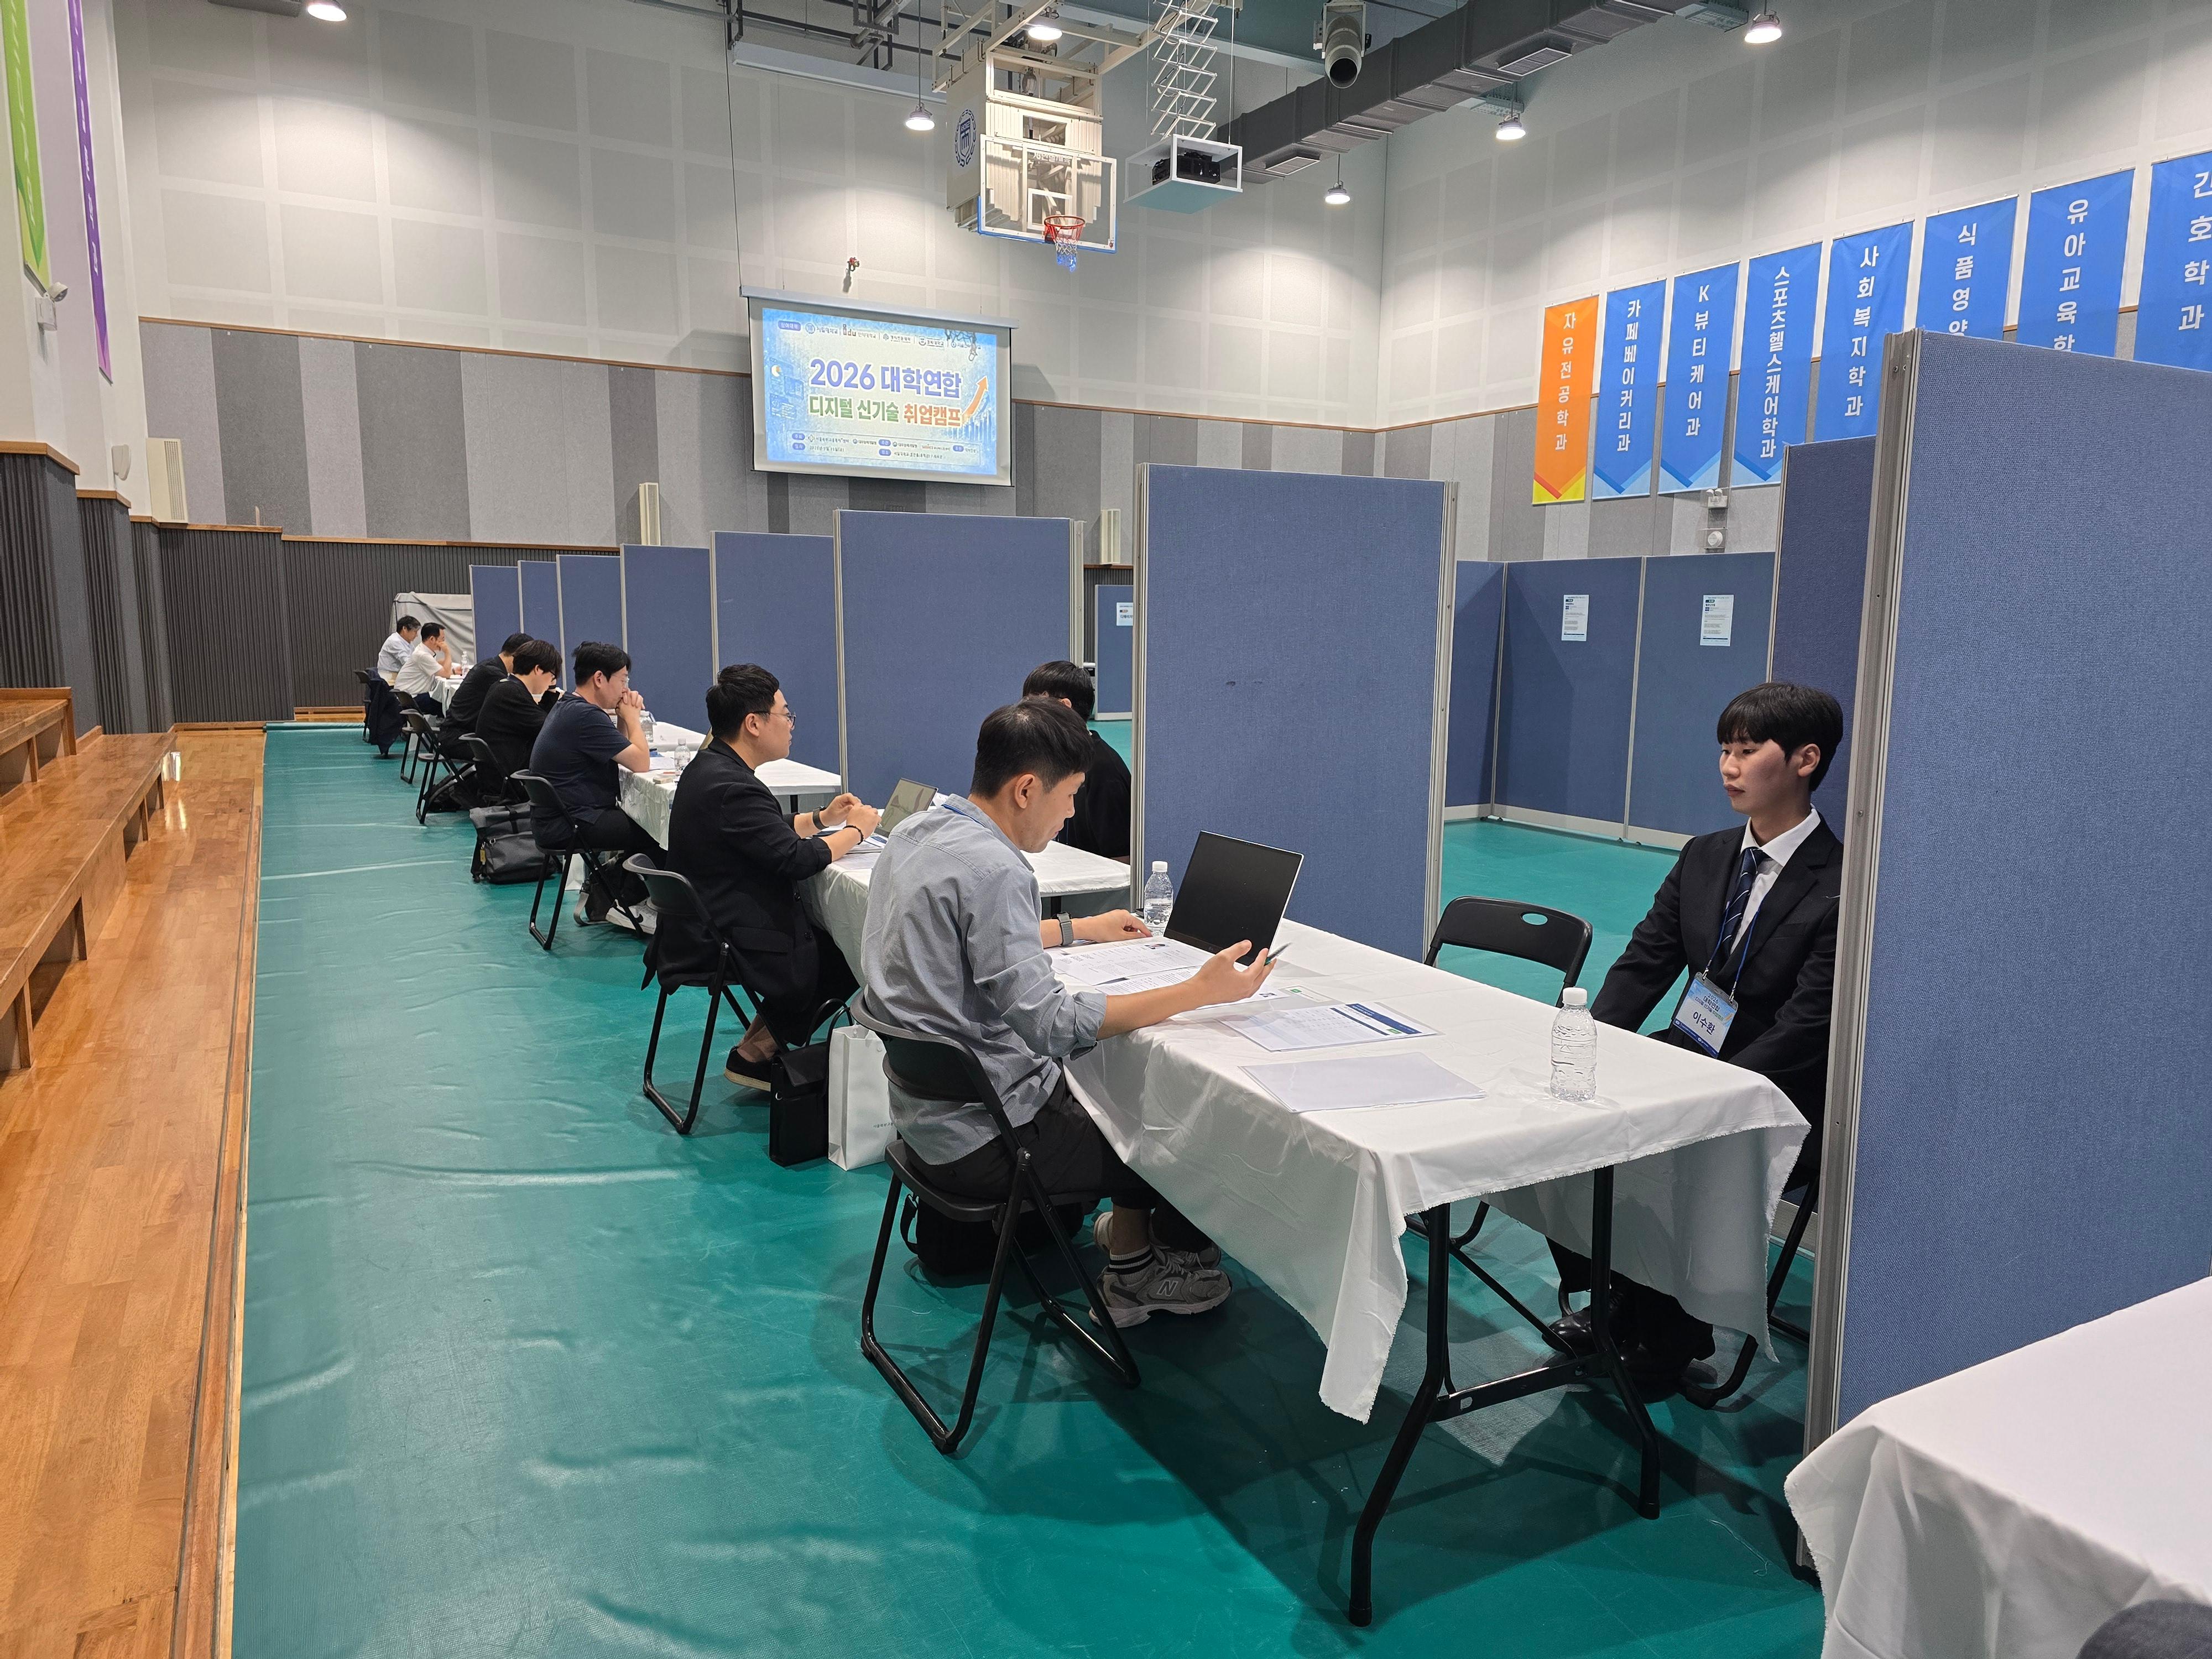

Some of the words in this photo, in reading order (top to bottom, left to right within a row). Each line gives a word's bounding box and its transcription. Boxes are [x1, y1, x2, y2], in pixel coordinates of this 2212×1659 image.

[1686, 285, 1710, 436] K뷰티케어과
[1760, 267, 1790, 458] 스포츠헬스케어학과
[1844, 246, 1879, 416] 사회복지학과
[810, 359, 875, 390] 2026
[881, 366, 962, 398] 대학연합
[810, 396, 853, 418] 디지털
[857, 400, 899, 422] 신기술
[904, 404, 961, 426] 취업캠프
[1554, 312, 1577, 451] 자유전공학과
[1616, 300, 1641, 452] 카페베이커리과
[1693, 1011, 1715, 1036] 이수환
[1708, 993, 1719, 1004] 2026
[1156, 1279, 1179, 1296] N
